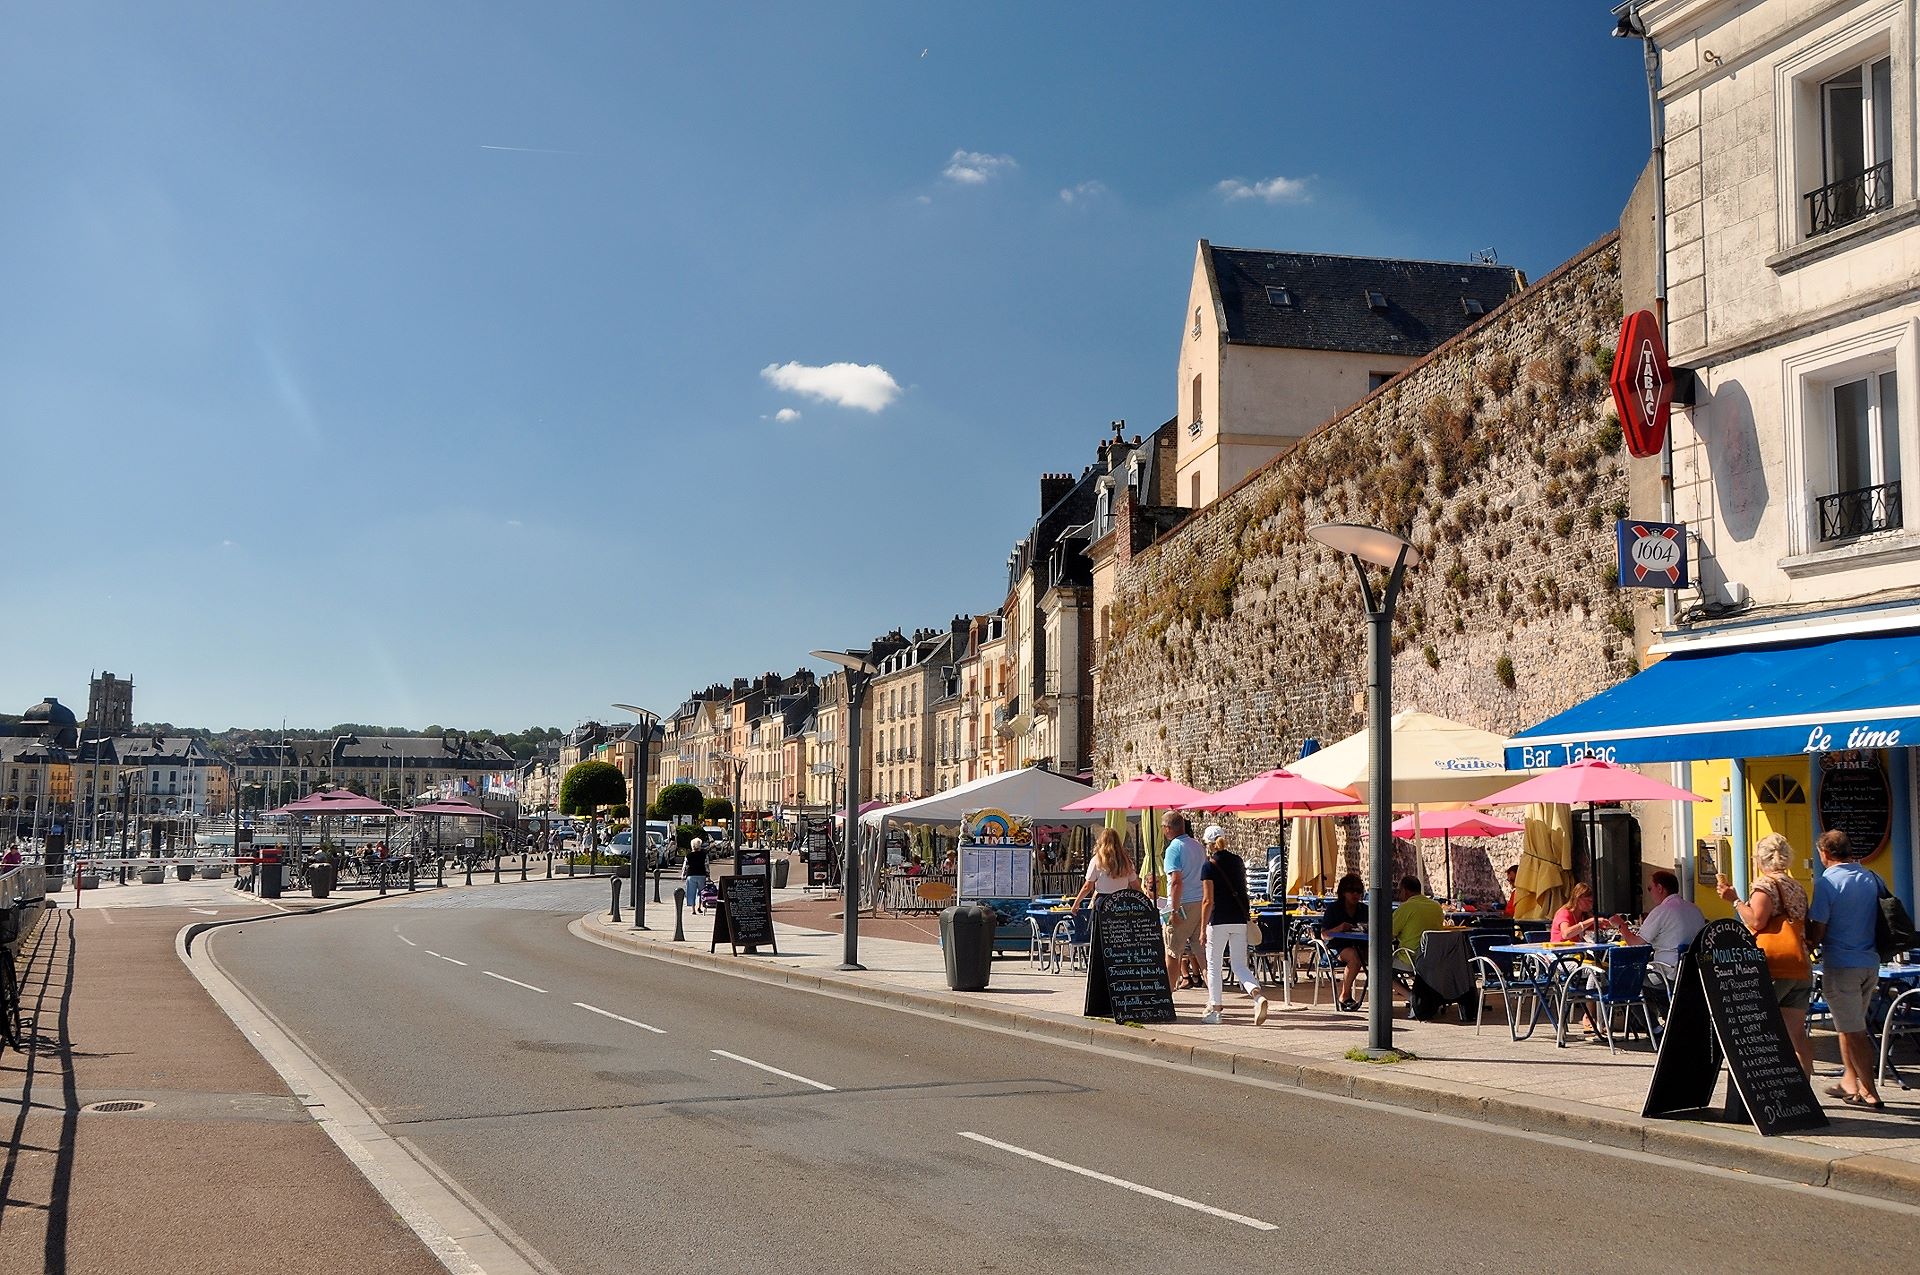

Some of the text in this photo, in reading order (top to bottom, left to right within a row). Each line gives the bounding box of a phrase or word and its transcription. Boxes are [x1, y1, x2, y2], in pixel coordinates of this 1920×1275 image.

[1643, 350, 1655, 416] TABAC
[1637, 540, 1675, 562] 1664
[1803, 725, 1901, 753] Le time
[1522, 746, 1551, 768] Bar
[1834, 760, 1869, 769] TIME
[974, 836, 1015, 845] TIME
